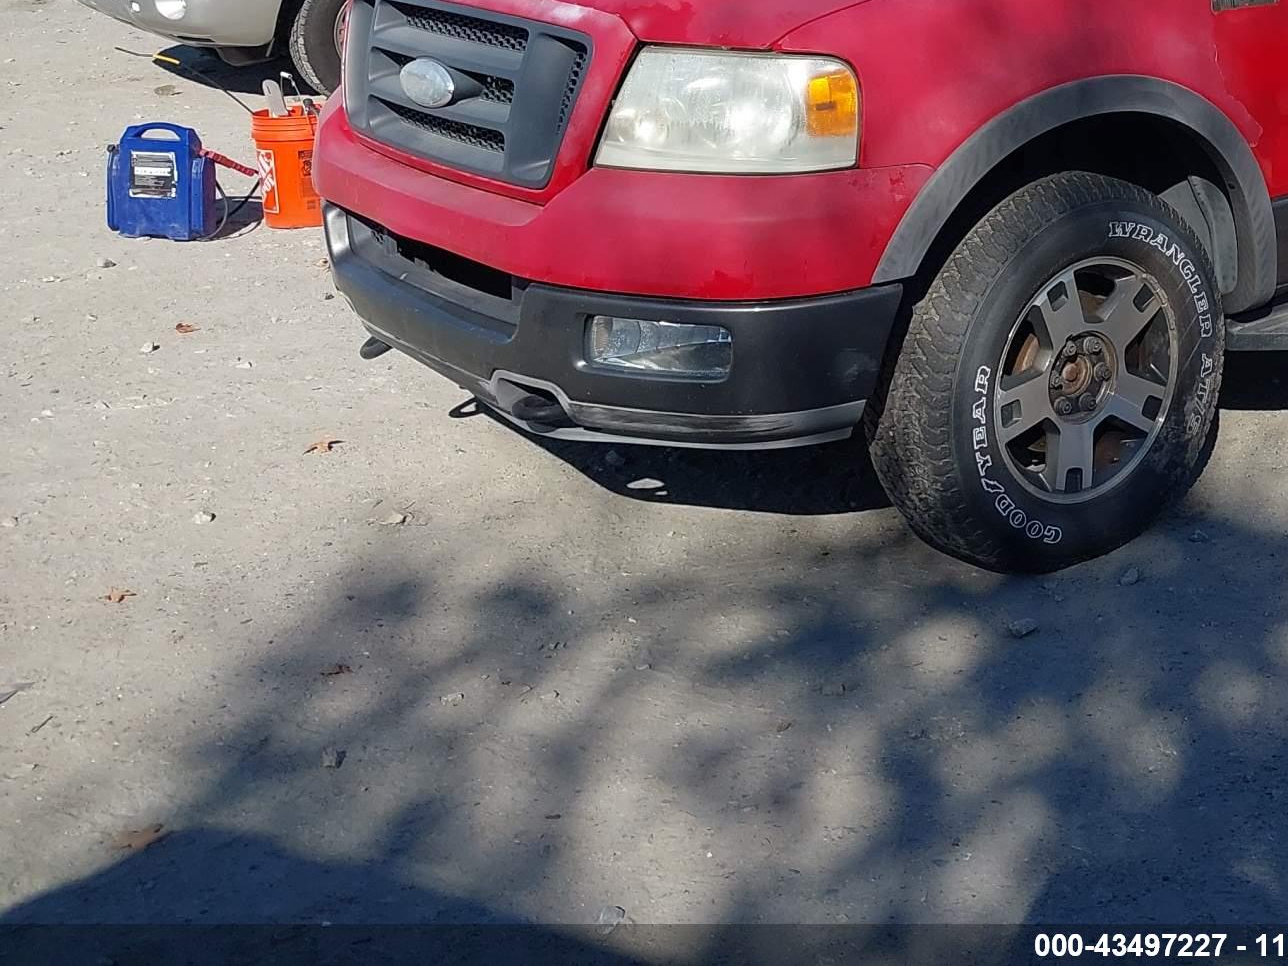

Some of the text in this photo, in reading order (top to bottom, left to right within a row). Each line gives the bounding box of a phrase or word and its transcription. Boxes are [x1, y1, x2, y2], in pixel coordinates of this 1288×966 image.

[1108, 221, 1213, 434] WRANGLER AT/S
[972, 365, 1062, 545] GOODYEAR
